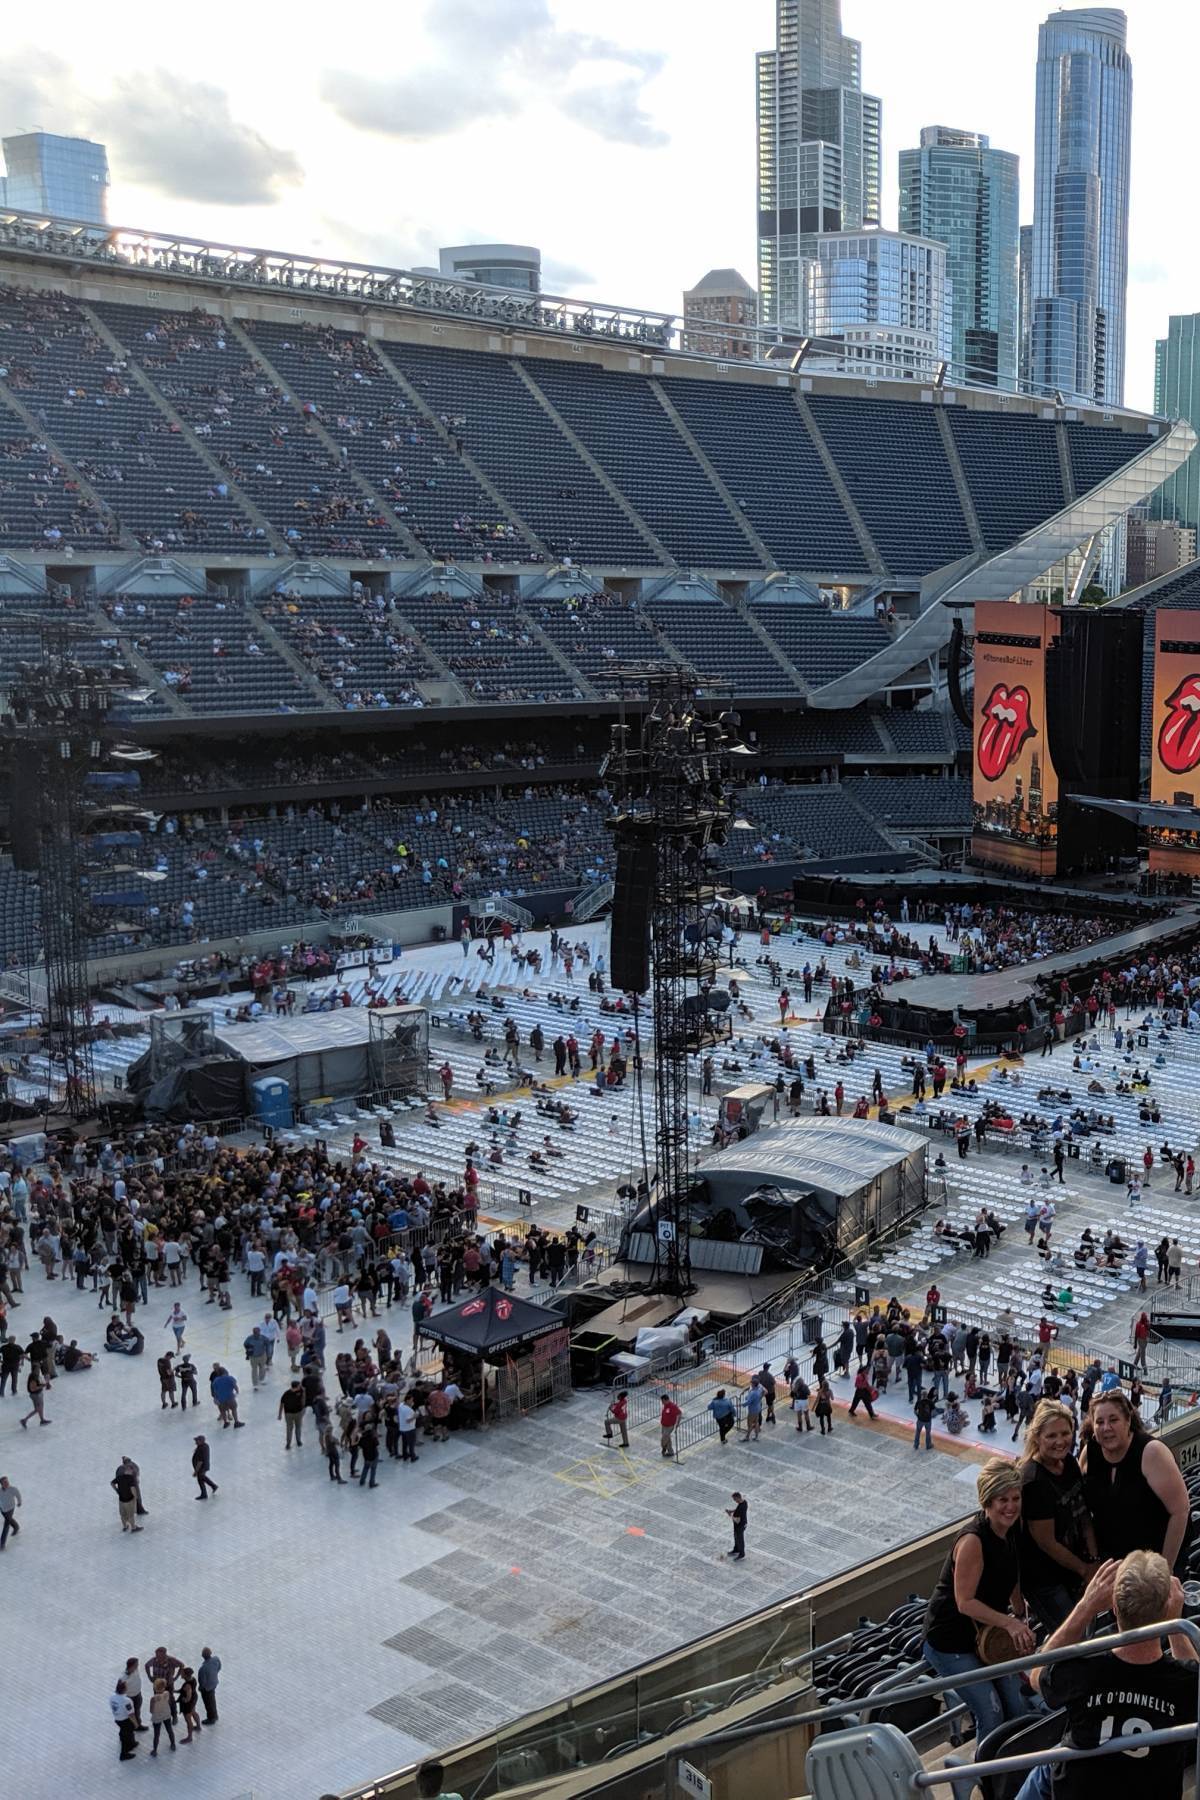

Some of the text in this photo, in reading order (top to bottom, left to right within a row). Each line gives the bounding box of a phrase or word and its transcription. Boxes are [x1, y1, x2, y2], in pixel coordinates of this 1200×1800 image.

[521, 1191, 528, 1203] K
[935, 1308, 943, 1321] H
[488, 1321, 564, 1354] OFFICIAL MERCHANDISE
[1122, 1364, 1130, 1378] H
[1181, 1445, 1198, 1465] 314
[1107, 1691, 1176, 1717] O'DONNELL'S
[686, 1768, 704, 1790] 315
